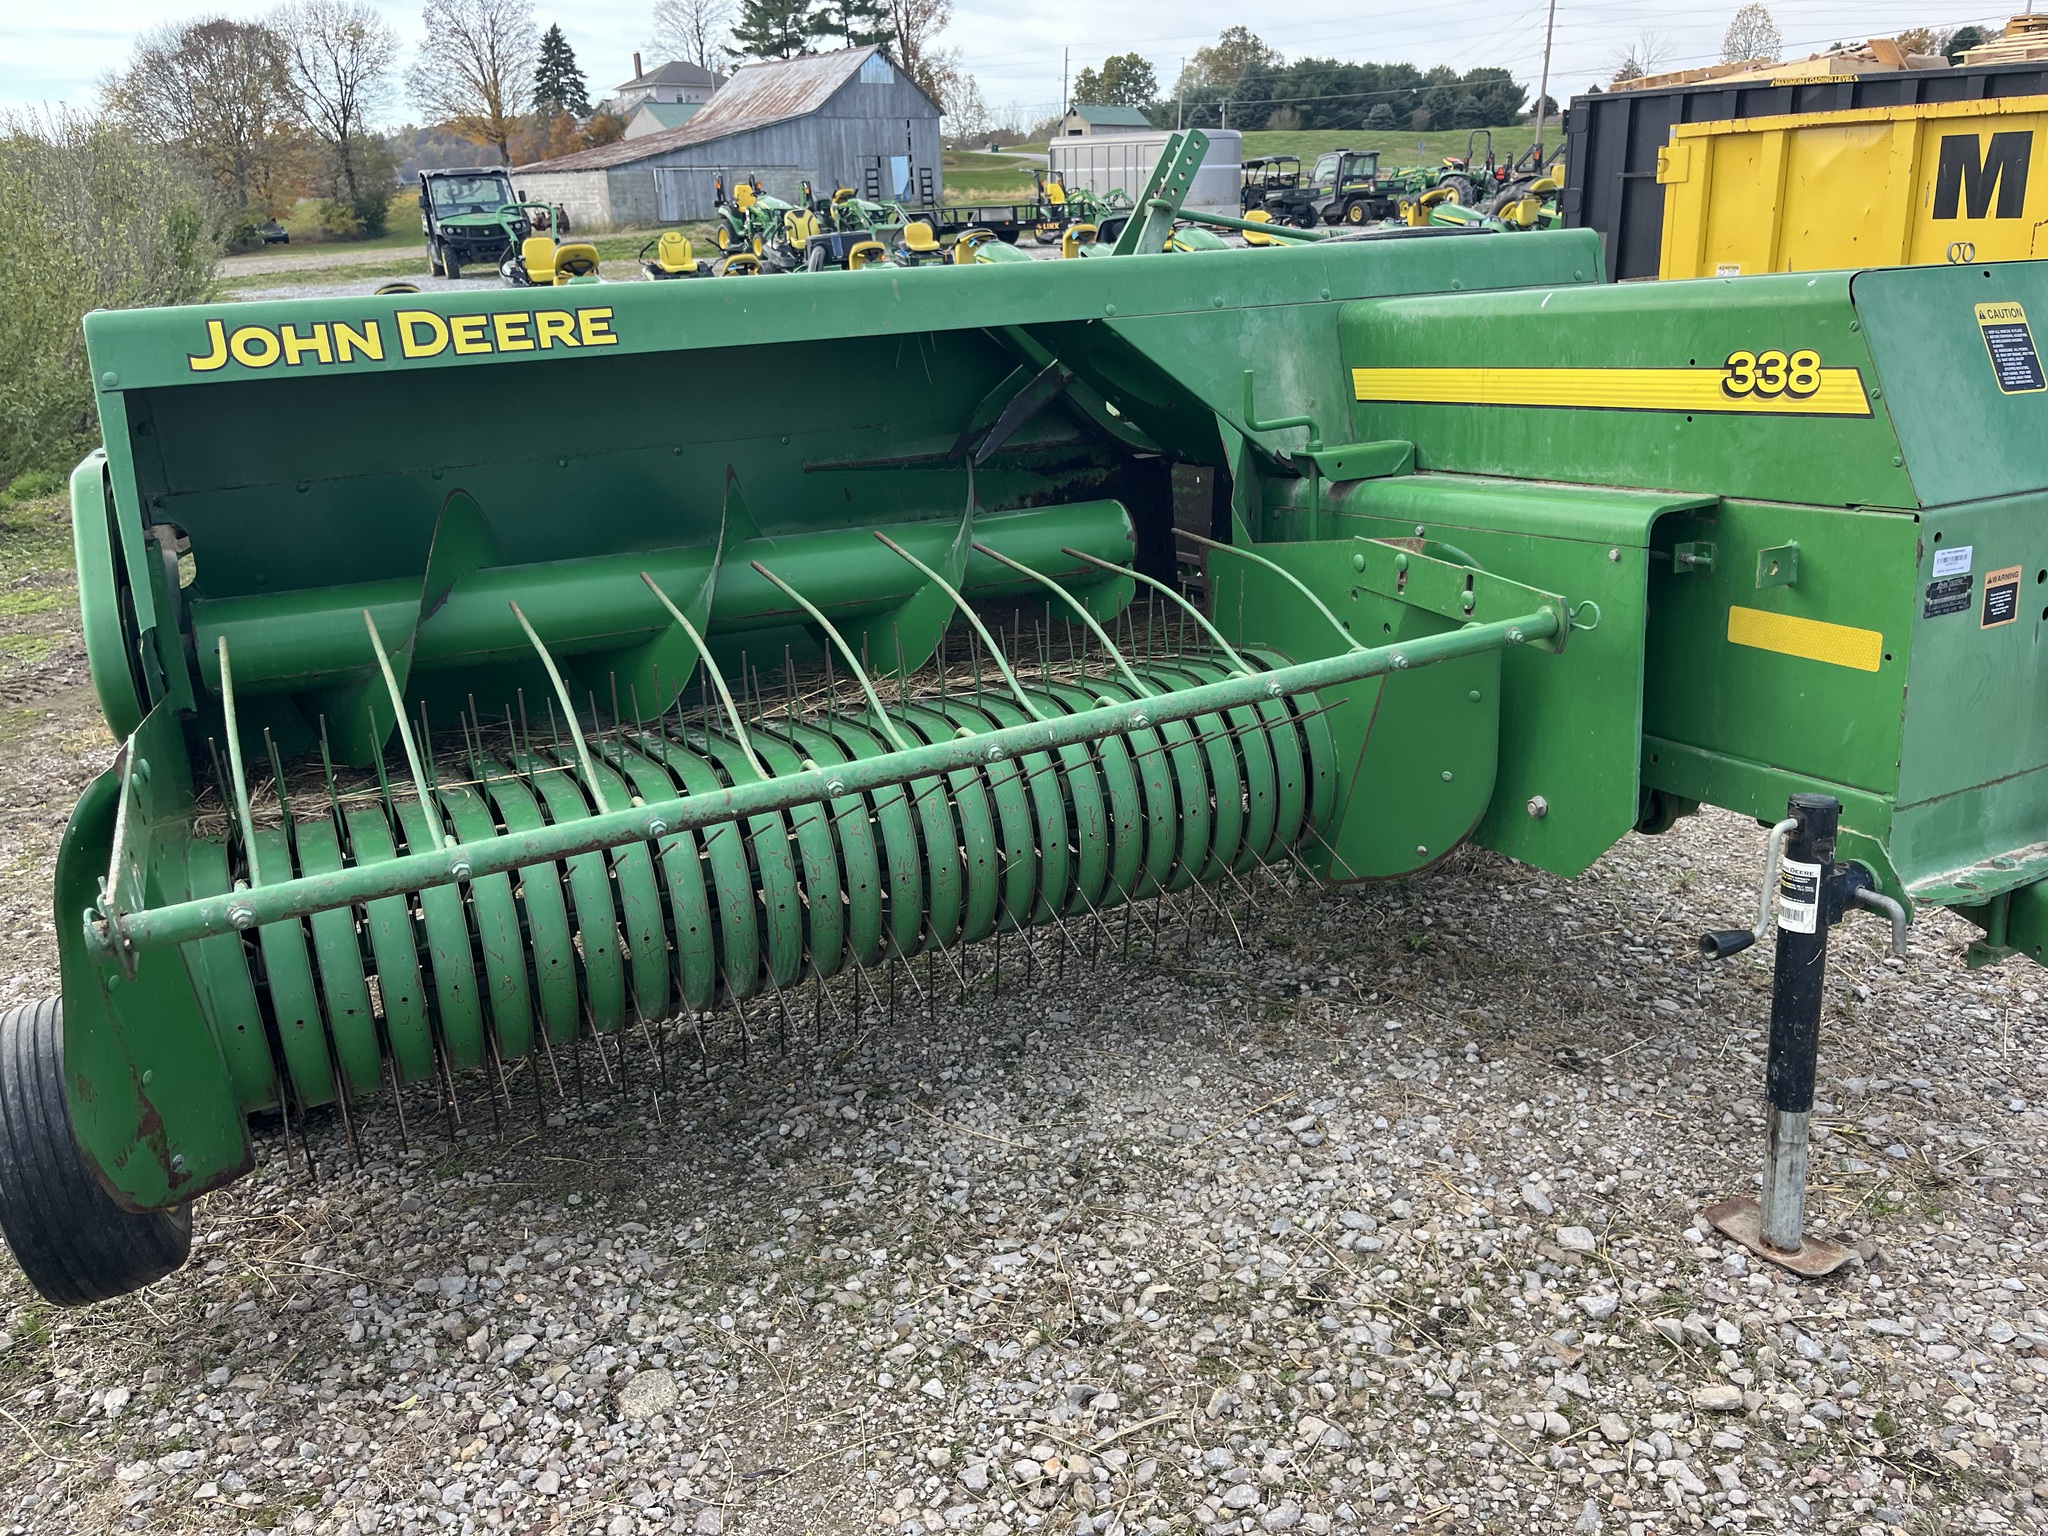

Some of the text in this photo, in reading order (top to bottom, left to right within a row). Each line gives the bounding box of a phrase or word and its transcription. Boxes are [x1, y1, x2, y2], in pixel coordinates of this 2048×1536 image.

[1775, 75, 1853, 86] MAXIMUM LOADING LEVEL
[1932, 131, 2034, 219] M
[1043, 222, 1060, 230] LINX
[1987, 308, 2023, 319] CAUTION
[187, 306, 620, 372] JOHN DEERE
[1722, 349, 1821, 399] 338
[1992, 571, 2019, 583] WARNING
[1790, 867, 1814, 876] DEERE
